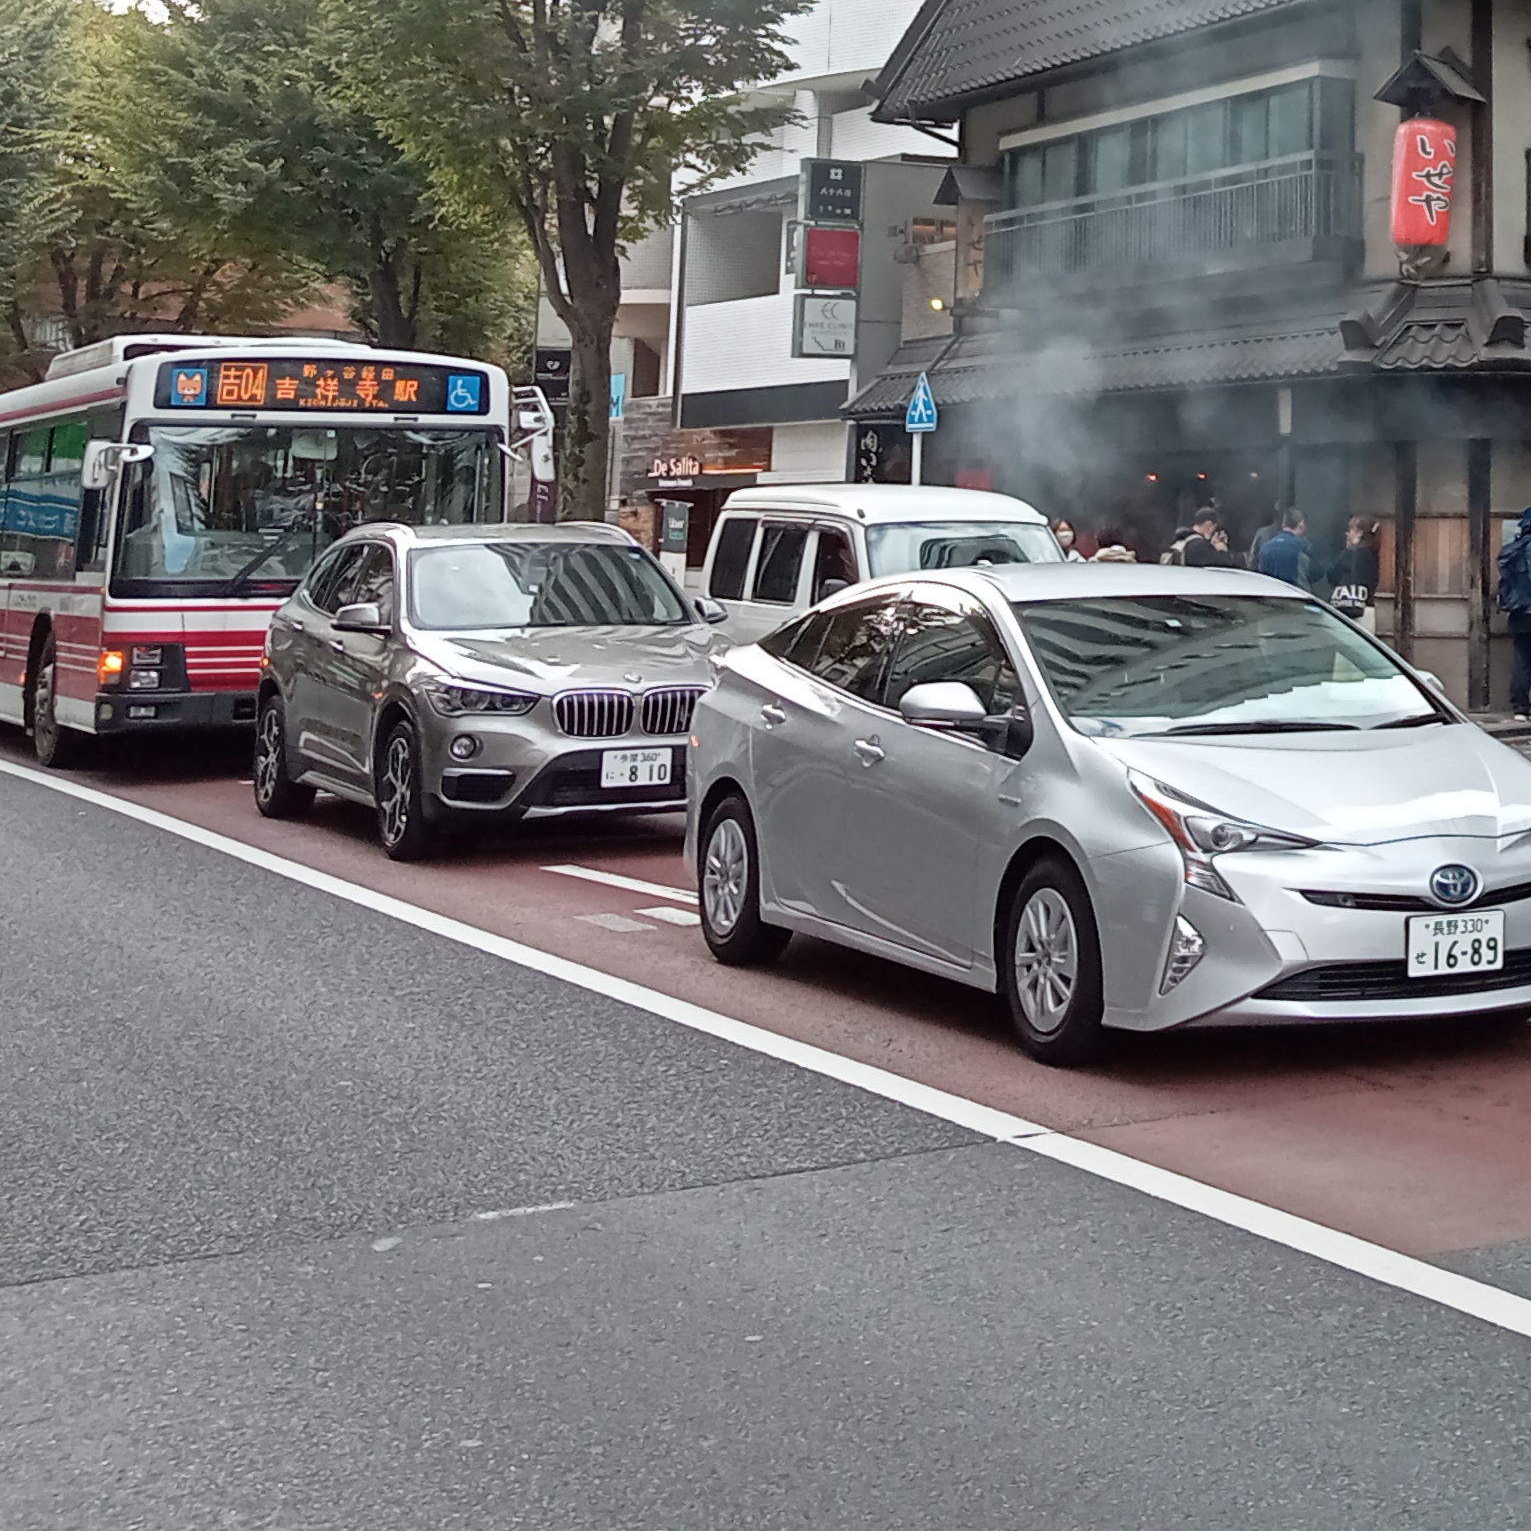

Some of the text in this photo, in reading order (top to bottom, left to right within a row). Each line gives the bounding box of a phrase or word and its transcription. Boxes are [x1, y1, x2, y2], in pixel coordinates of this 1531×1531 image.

[1408, 134, 1456, 226] いせや
[219, 366, 264, 401] 吉04
[275, 377, 418, 404] 吉祥寺駅
[648, 456, 700, 478] De Salita
[1414, 936, 1499, 971] せ 16-89
